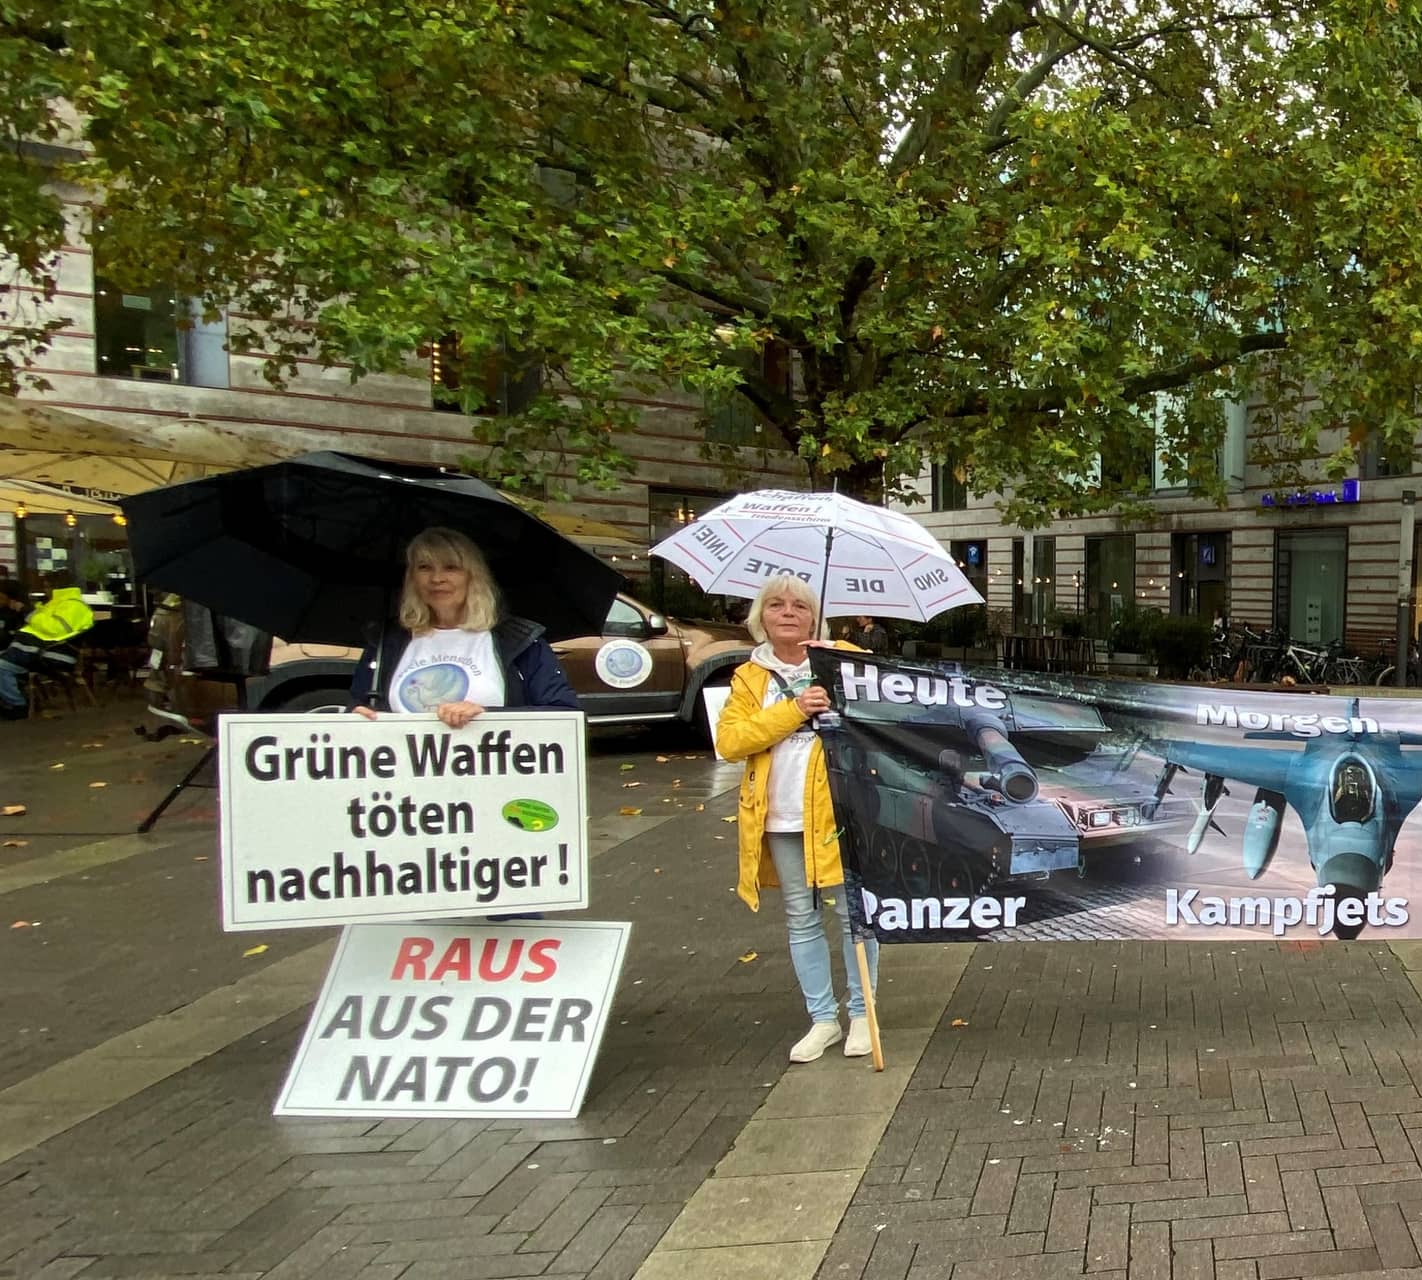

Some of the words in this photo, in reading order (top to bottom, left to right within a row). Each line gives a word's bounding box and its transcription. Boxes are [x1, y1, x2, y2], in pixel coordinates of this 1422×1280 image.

[840, 661, 1006, 709] Heute
[1196, 703, 1379, 738] Morgen
[245, 733, 396, 782] Grüne
[405, 730, 565, 778] Waffen
[347, 792, 473, 838] töten
[247, 847, 547, 903] nachhaltiger
[861, 886, 1027, 931] Panzer
[1165, 884, 1410, 936] Kampfjets
[390, 937, 561, 982] RAUS
[321, 995, 452, 1041] AUS
[462, 996, 593, 1042] DER
[336, 1055, 540, 1104] NATO!
